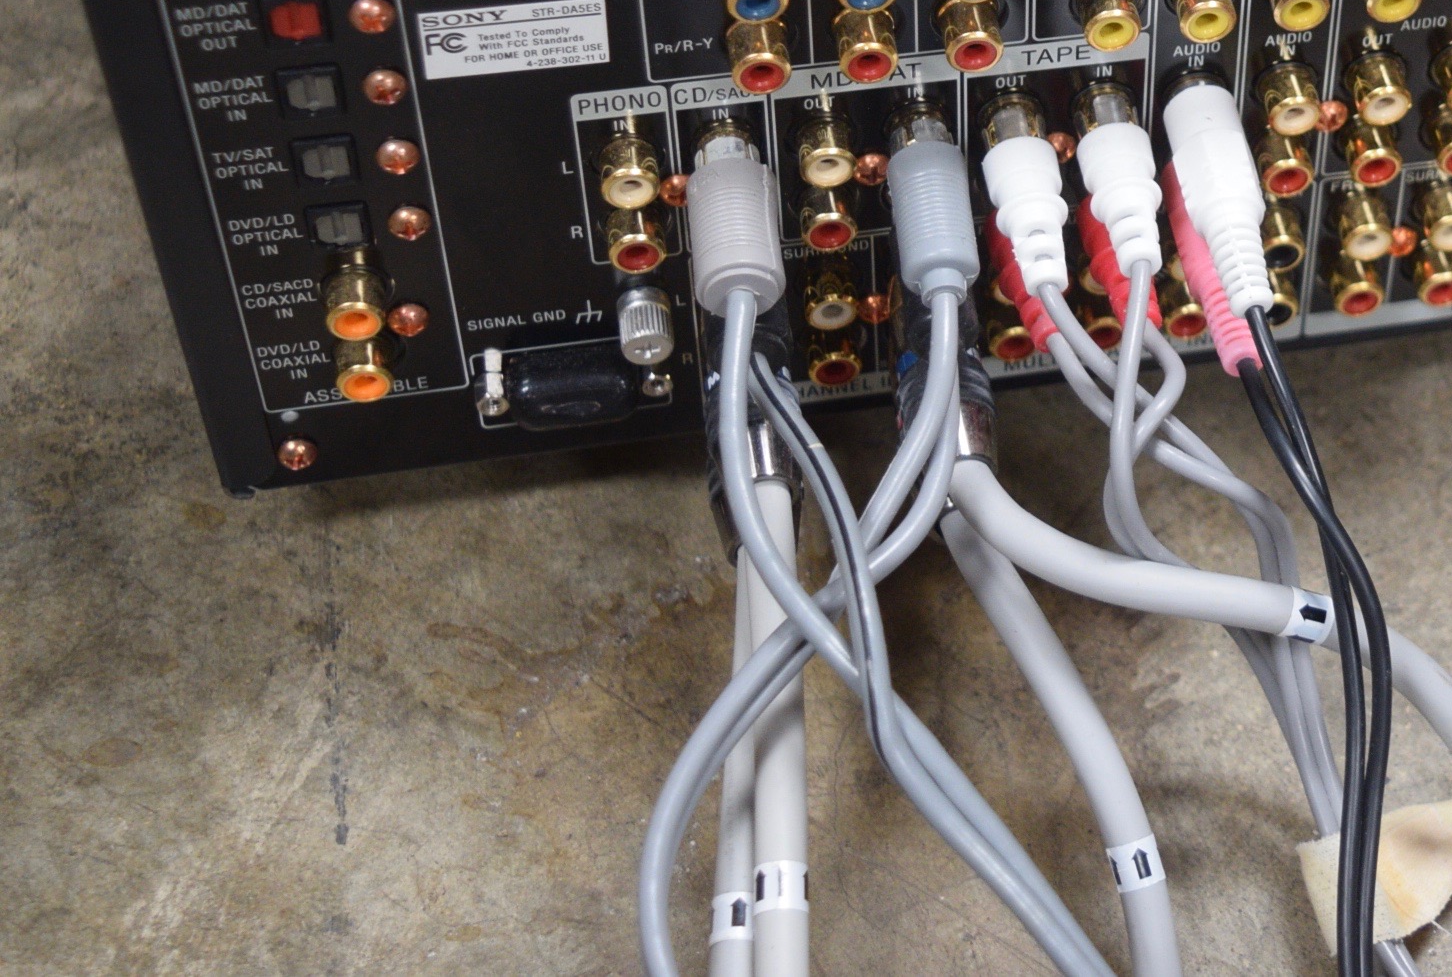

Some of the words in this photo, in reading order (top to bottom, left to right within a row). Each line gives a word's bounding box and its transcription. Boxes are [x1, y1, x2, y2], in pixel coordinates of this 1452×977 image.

[174, 1, 248, 20] MD/DAT
[421, 9, 508, 28] SONY
[531, 2, 602, 18] STR-DA5ES
[179, 17, 257, 36] OPTICAL
[1401, 15, 1448, 32] AUDIO
[201, 34, 239, 51] OUT
[477, 31, 511, 42] Tested
[515, 30, 528, 39] To
[532, 26, 570, 38] Comply
[478, 40, 503, 51] With
[507, 39, 528, 48] FCC
[532, 34, 584, 46] Standards
[1265, 31, 1312, 47] AUDIO
[464, 54, 485, 64] FOR
[489, 51, 519, 61] HOME
[523, 49, 538, 58] OR
[541, 45, 578, 57] OFFICE
[582, 42, 603, 52] USE
[1021, 44, 1091, 67] TAPE
[1173, 41, 1221, 58] AUDIO
[526, 54, 596, 68] 4-238-302-11
[598, 53, 606, 61] U
[1188, 55, 1204, 68] IN
[811, 62, 922, 90] MDAT
[1096, 64, 1112, 77] IN
[193, 74, 265, 94] MD/DAT
[995, 74, 1027, 89] OUT
[199, 89, 273, 110] OPTICAL
[907, 85, 923, 99] IN
[578, 88, 662, 114] PHONO
[804, 96, 835, 110] OUT
[226, 108, 248, 122] IN
[712, 107, 729, 120] IN
[612, 118, 630, 132] IN
[212, 146, 275, 164] TV/SAT
[215, 160, 289, 180] OPTICAL
[562, 161, 574, 175] L
[244, 176, 263, 190] IN
[228, 213, 295, 232] DVD/LD
[232, 227, 304, 246] OPTICAL
[571, 225, 583, 239] R
[259, 243, 279, 257] IN
[241, 278, 315, 297] CD/SACD
[245, 290, 318, 310] COAXIAL
[676, 293, 687, 308] L
[275, 306, 294, 320] IN
[467, 313, 527, 331] SIGNAL
[533, 308, 566, 323] GND
[257, 339, 321, 358] DVD/LD
[260, 352, 331, 371] COAXIAL
[290, 367, 308, 381] IN
[304, 375, 430, 406] ASSBLE
